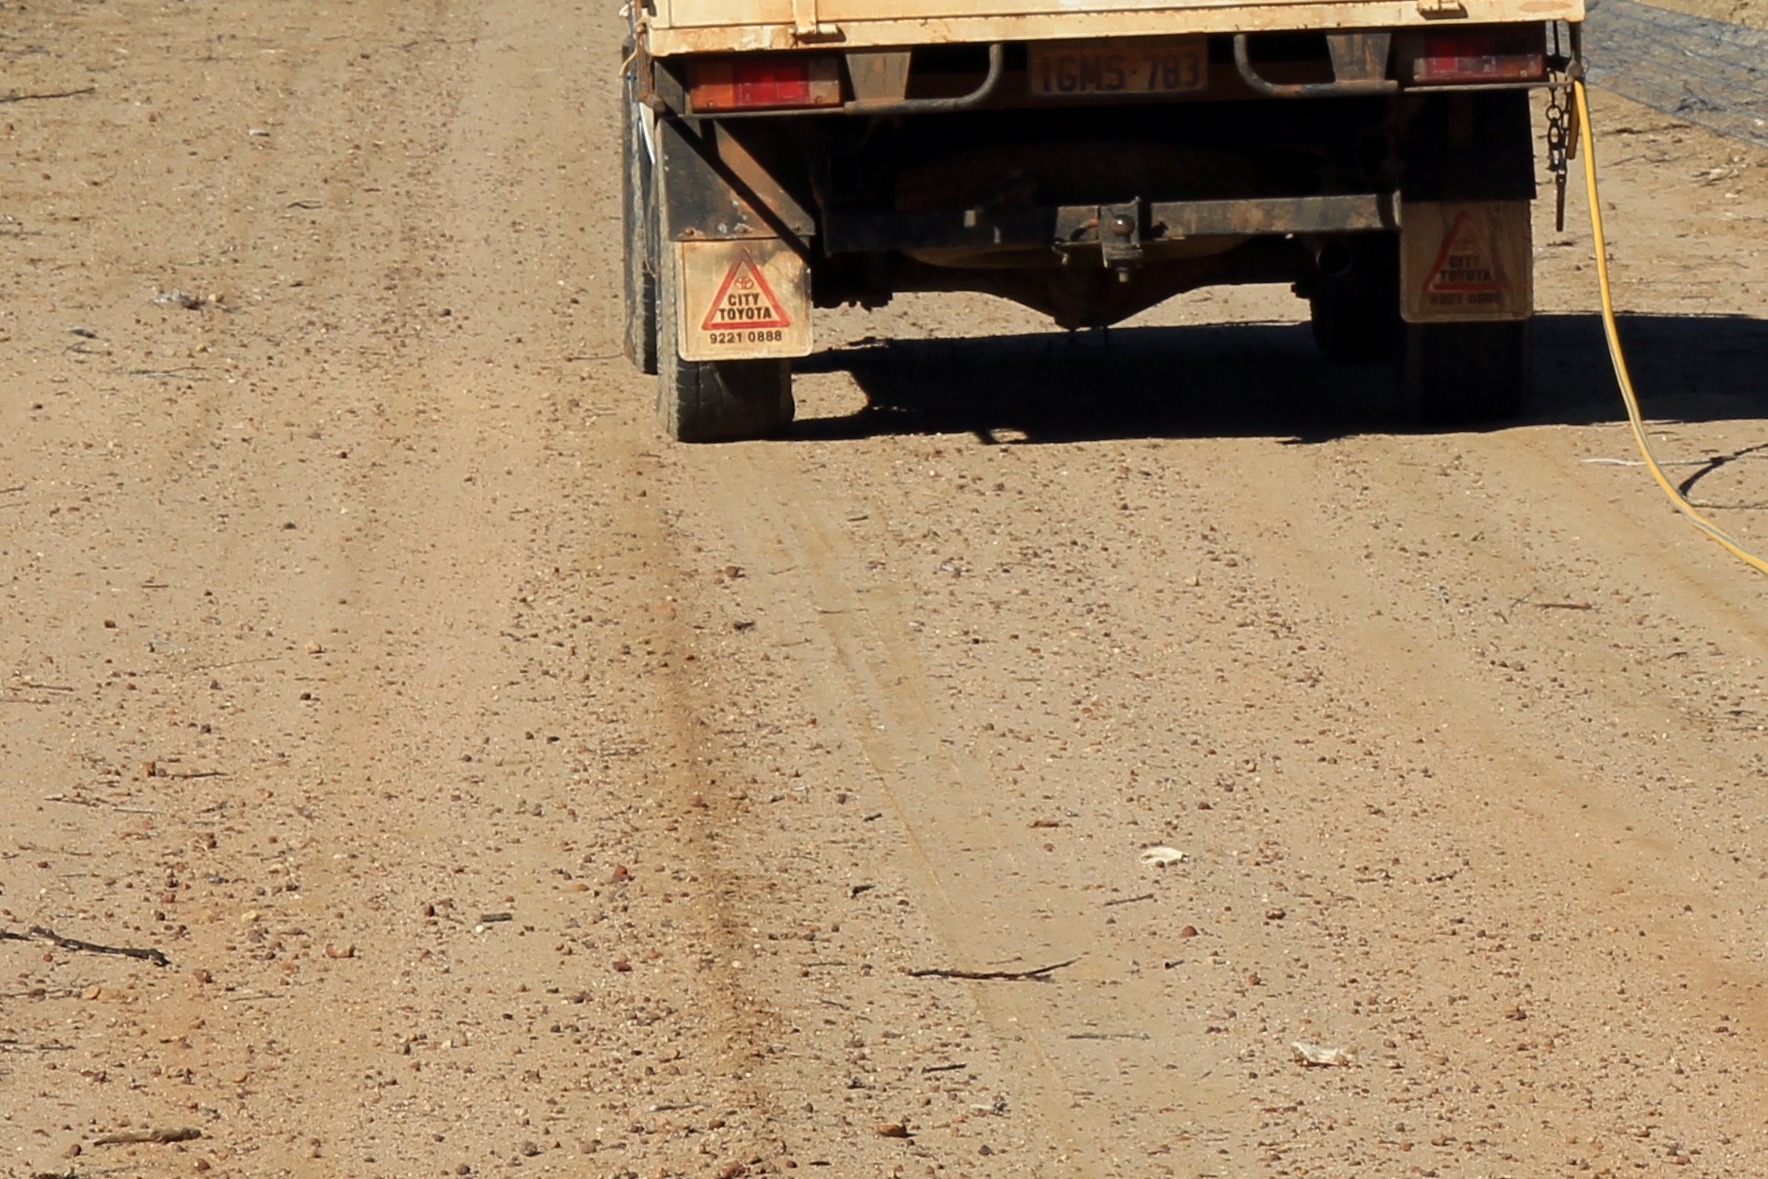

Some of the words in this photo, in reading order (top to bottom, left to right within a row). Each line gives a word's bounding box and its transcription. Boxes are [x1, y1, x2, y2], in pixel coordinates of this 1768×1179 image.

[1448, 255, 1481, 268] CITY
[1440, 269, 1492, 282] TOYOTA
[727, 292, 760, 306] CITY
[718, 306, 772, 321] TOYOTA
[709, 331, 743, 344] 9221
[747, 330, 782, 343] 0888
